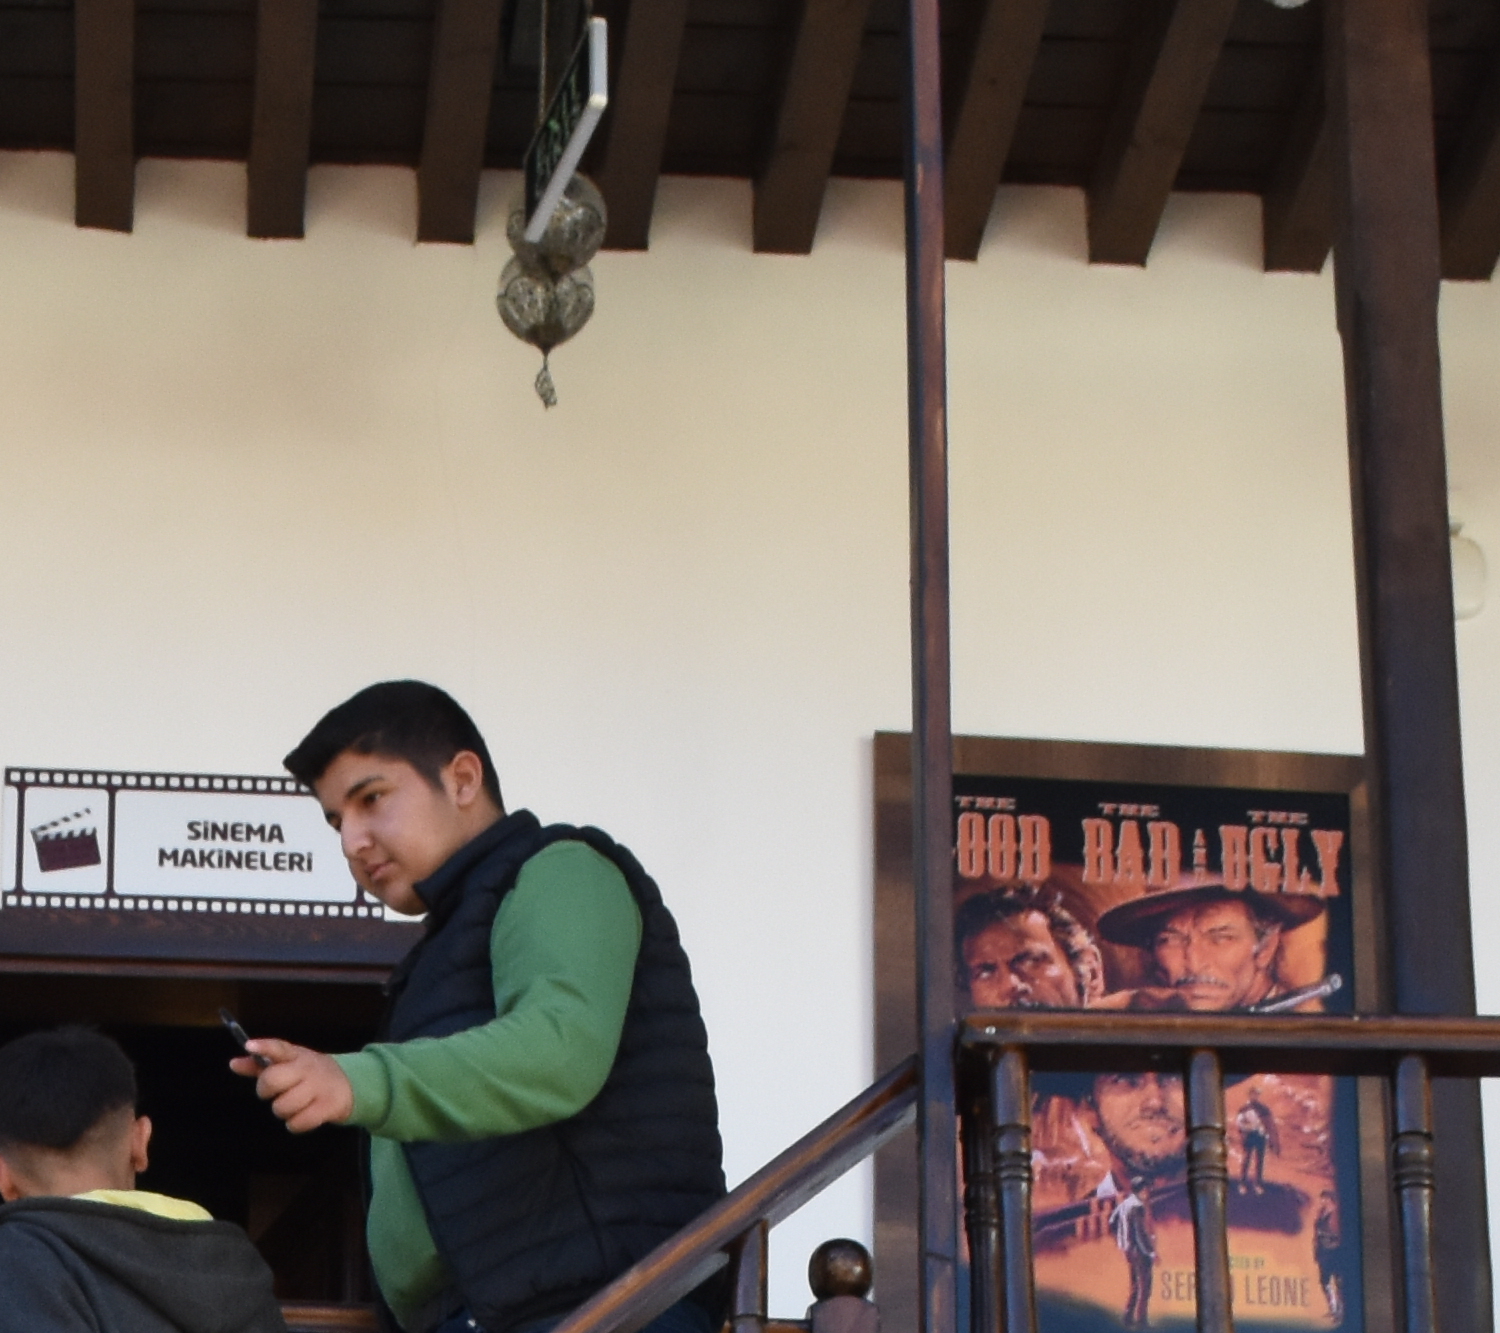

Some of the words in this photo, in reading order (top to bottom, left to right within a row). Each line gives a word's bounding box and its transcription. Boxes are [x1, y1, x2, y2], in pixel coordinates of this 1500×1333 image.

[955, 795, 1016, 810] THE
[1099, 802, 1159, 817] THE
[1247, 810, 1309, 826] THE
[187, 820, 284, 843] SİNEMA
[158, 847, 312, 872] MAKİNELERİ
[953, 811, 1051, 881] OOD
[1082, 817, 1182, 889] BAD
[1219, 824, 1344, 898] UGLY
[1245, 1274, 1310, 1307] LEONE
